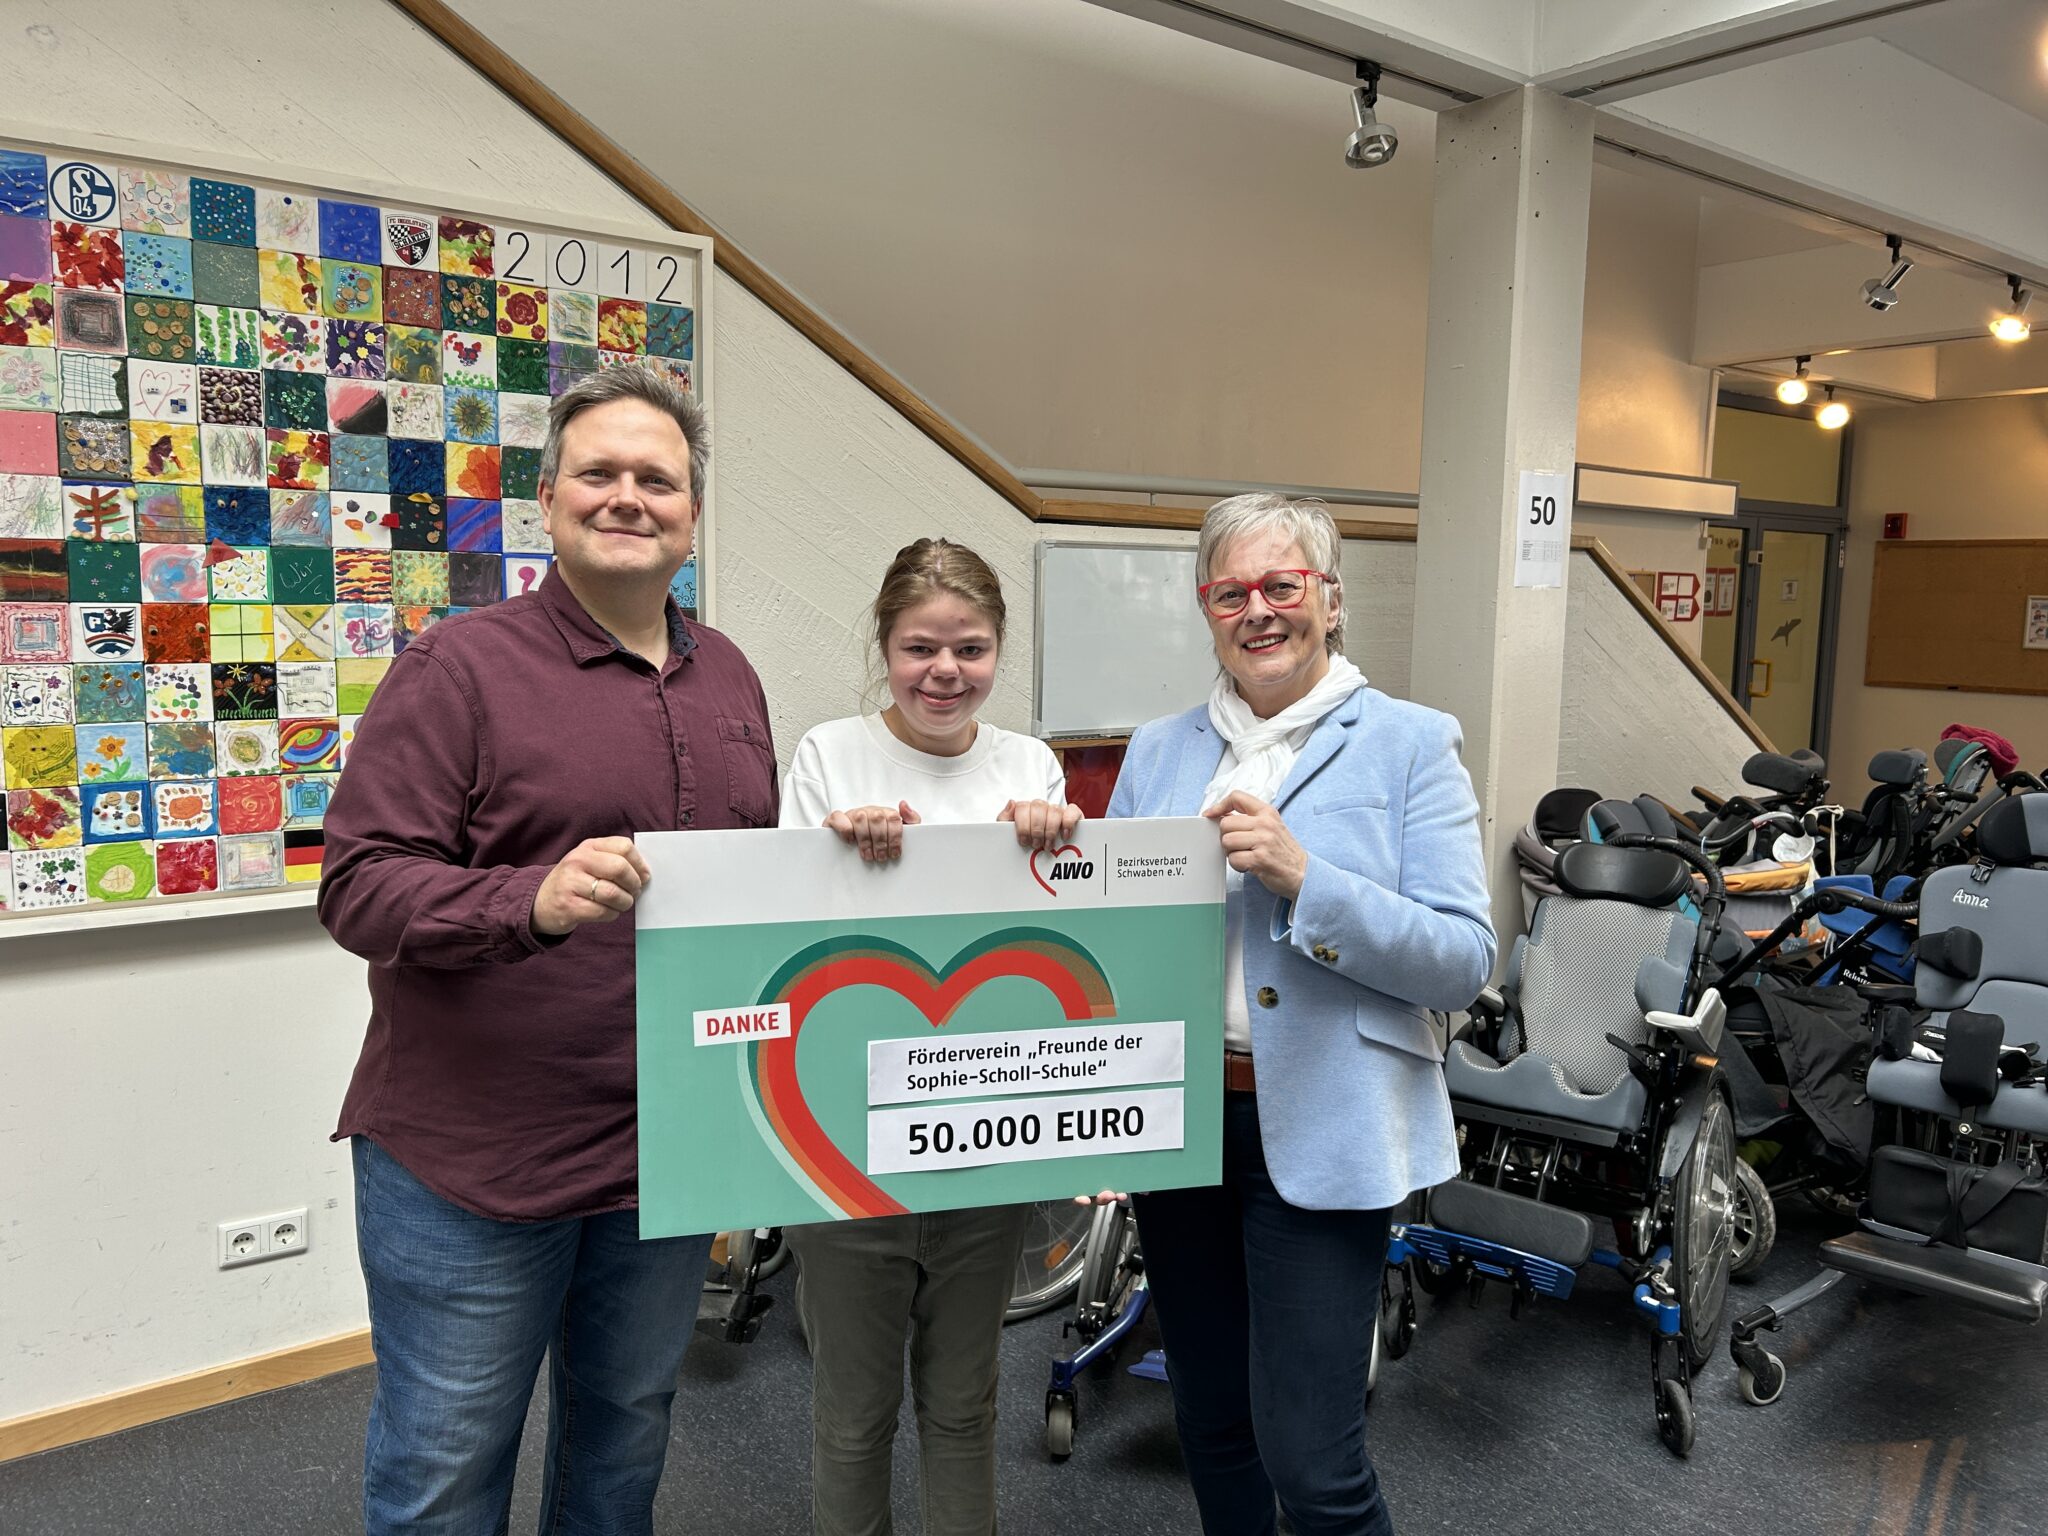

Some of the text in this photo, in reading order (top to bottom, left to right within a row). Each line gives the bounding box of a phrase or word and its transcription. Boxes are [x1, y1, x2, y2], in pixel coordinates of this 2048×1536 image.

[393, 230, 430, 249] SCHANZER
[1529, 495, 1556, 526] 50
[1049, 861, 1094, 881] AWO
[1117, 855, 1187, 867] Bezirksverband
[1117, 867, 1185, 878] Schwaben e.V.
[1952, 888, 1990, 908] Anna
[706, 1011, 780, 1037] DANKE
[908, 1034, 1143, 1066] Förderverein „Freunde der
[907, 1059, 1107, 1092] Sophie-Scholl-Schule“
[909, 1105, 1144, 1155] 50.000 EURO
